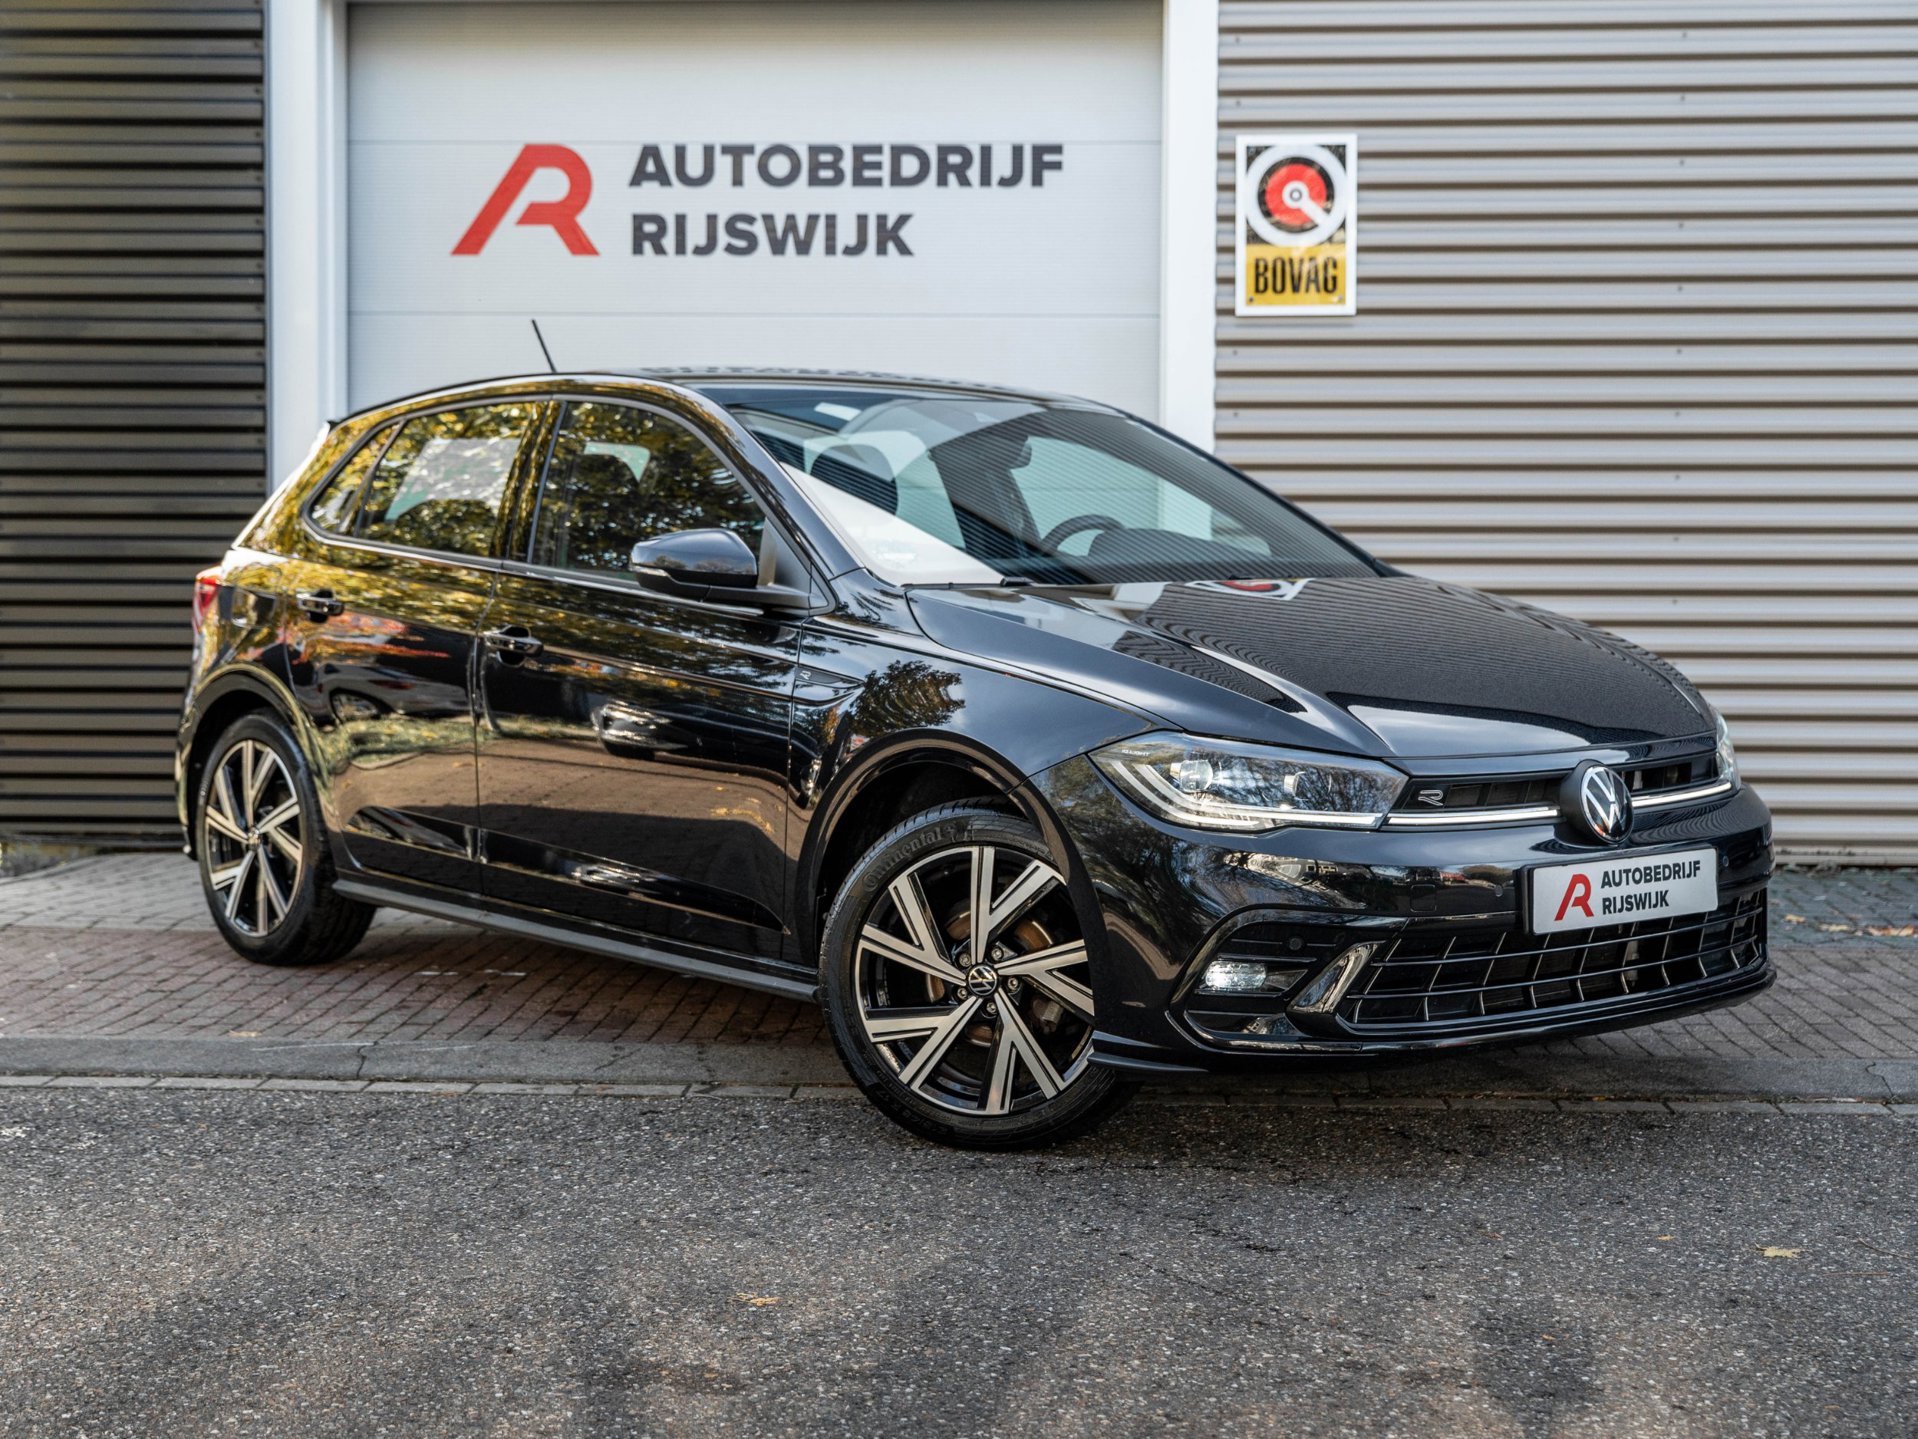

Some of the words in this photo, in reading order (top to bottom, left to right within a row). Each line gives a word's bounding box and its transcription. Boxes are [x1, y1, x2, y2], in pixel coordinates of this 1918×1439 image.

[629, 144, 1064, 187] AUTOBEDRIJF
[632, 213, 914, 256] RIJSWIJK
[1254, 257, 1337, 294] BOVAG
[863, 827, 944, 892] Continental
[1601, 860, 1701, 889] AUTOBEDRIJF
[1602, 890, 1669, 915] RIJSWIJK
